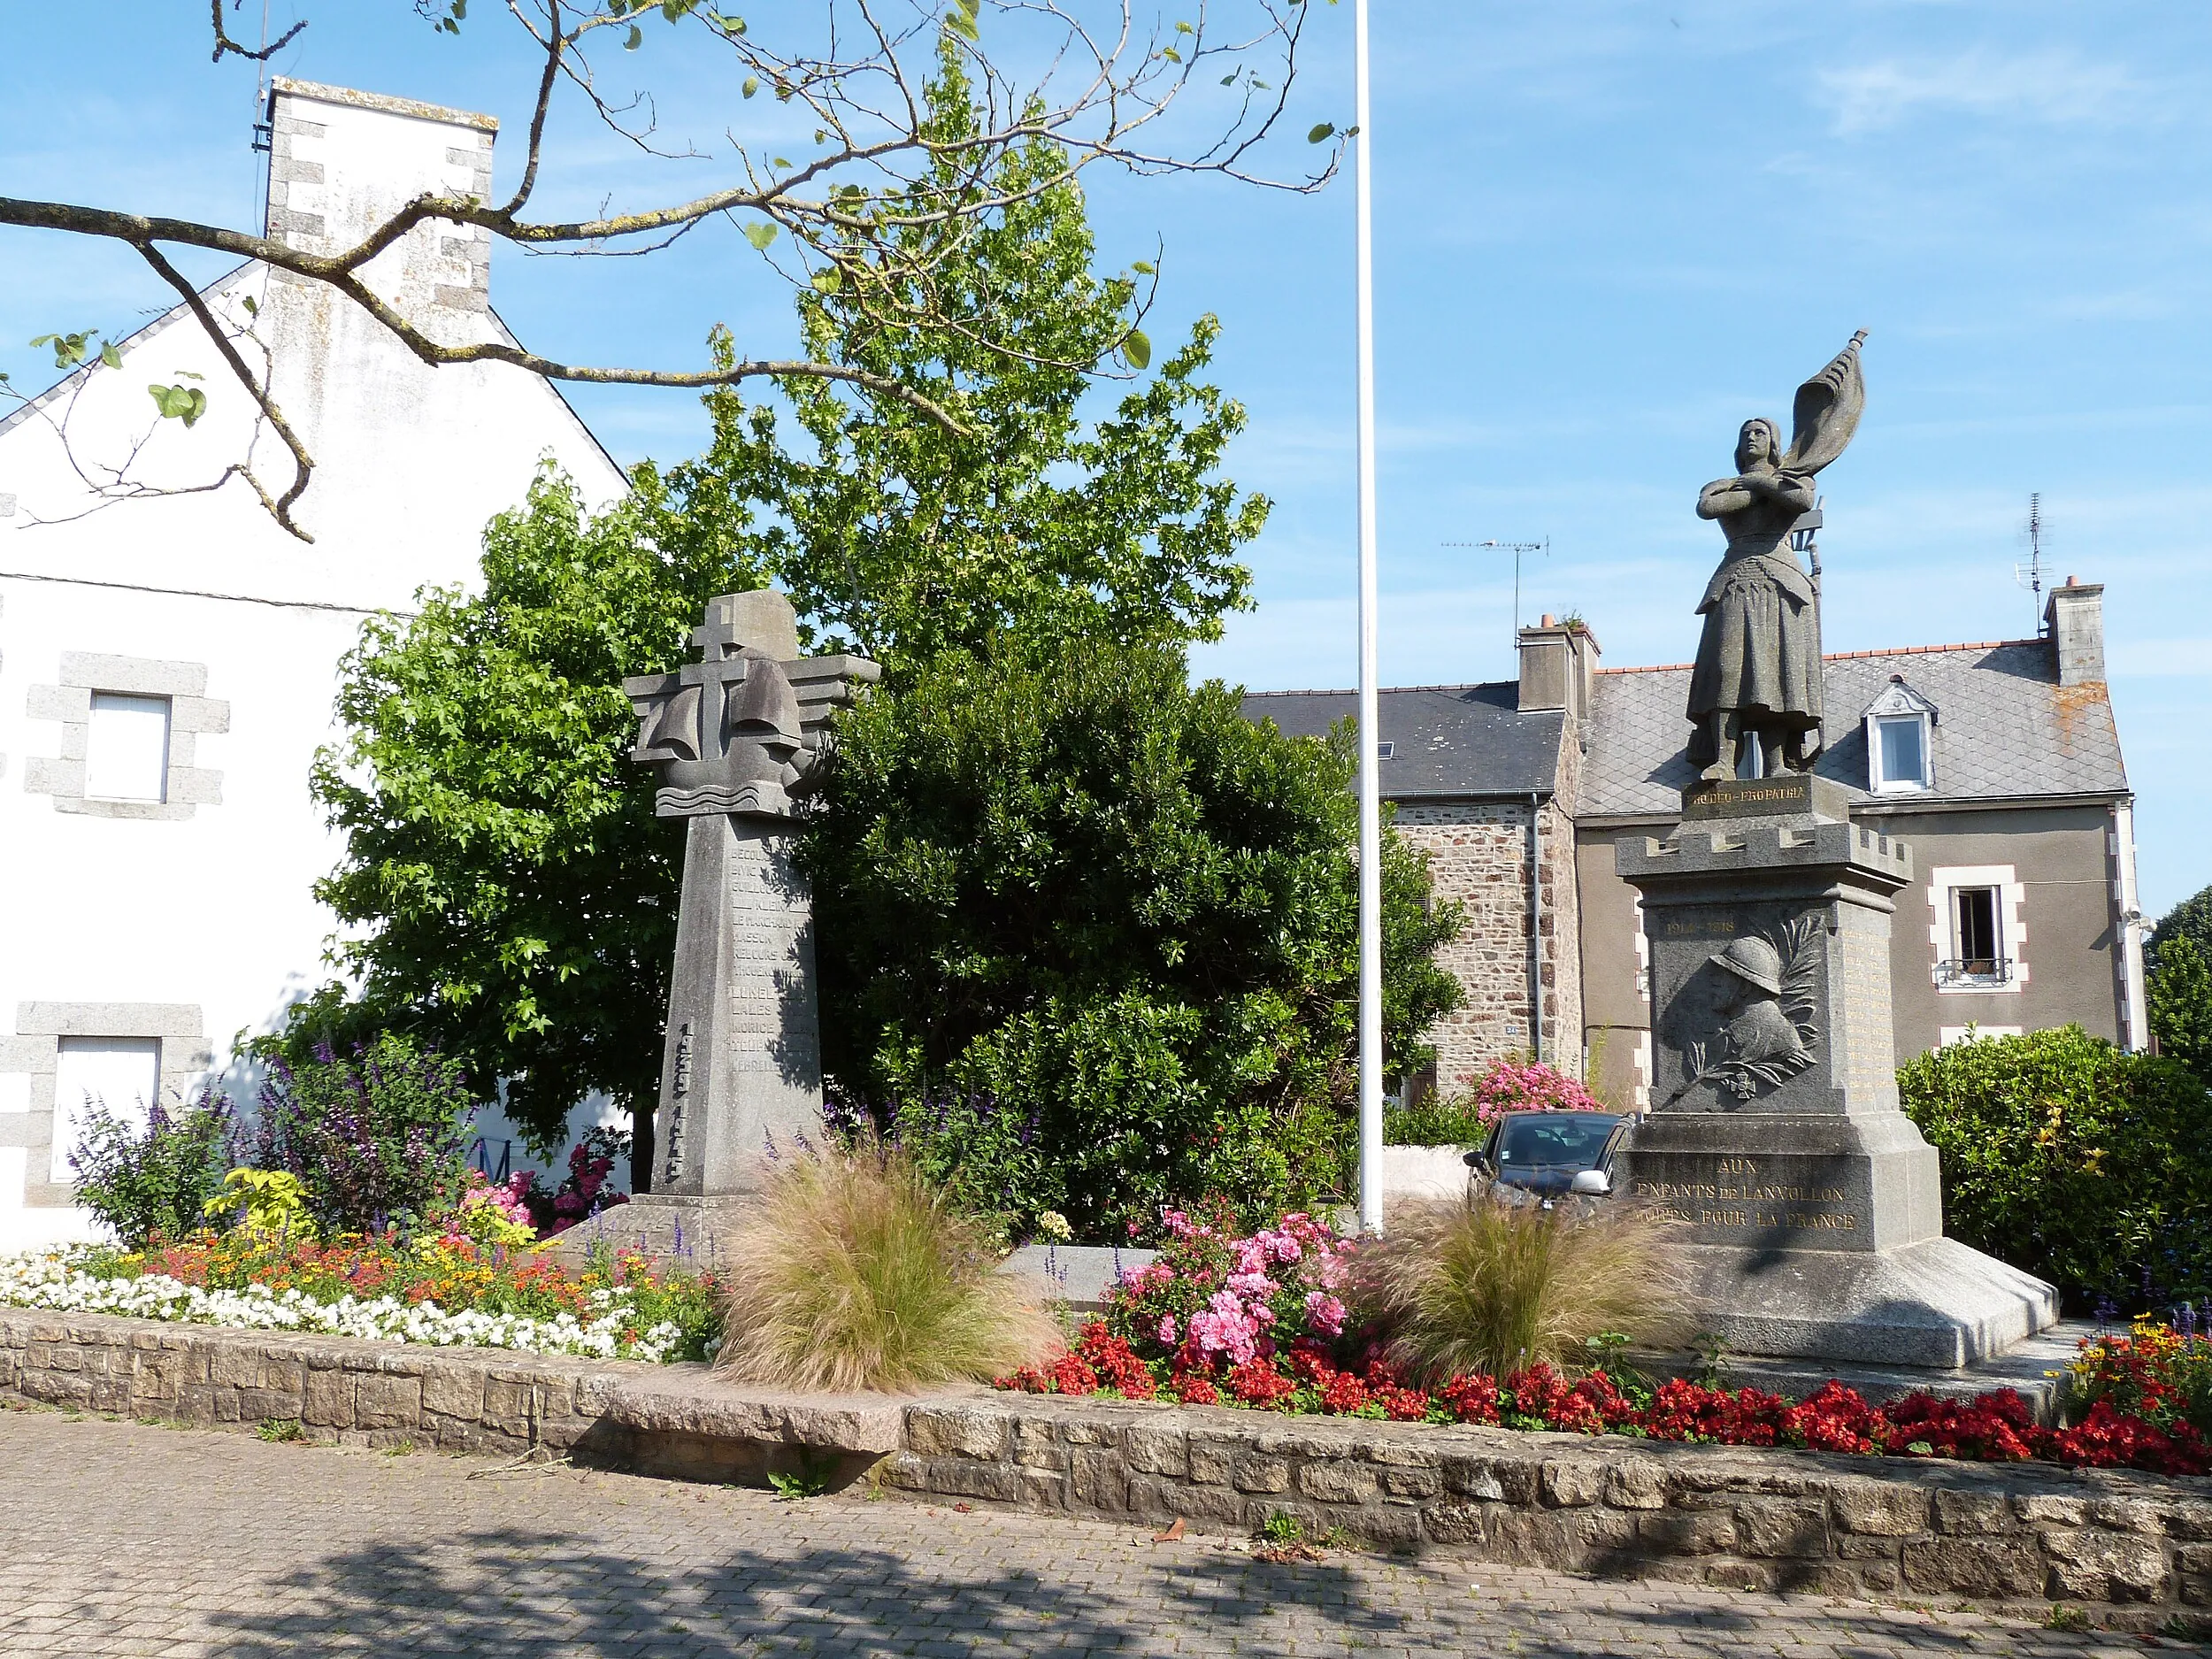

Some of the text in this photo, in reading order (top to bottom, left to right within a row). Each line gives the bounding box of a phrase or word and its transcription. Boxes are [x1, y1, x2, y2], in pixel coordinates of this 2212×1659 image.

[731, 987, 773, 1000] LUNEL
[732, 1021, 774, 1033] MORICE
[1717, 1158, 1757, 1174] AUX
[1637, 1182, 1716, 1199] ENFANTS
[1741, 1185, 1845, 1202] LANVOLLON
[1701, 1210, 1747, 1226] POUR
[1756, 1212, 1778, 1227] LA
[1786, 1214, 1856, 1231] FRANCE
